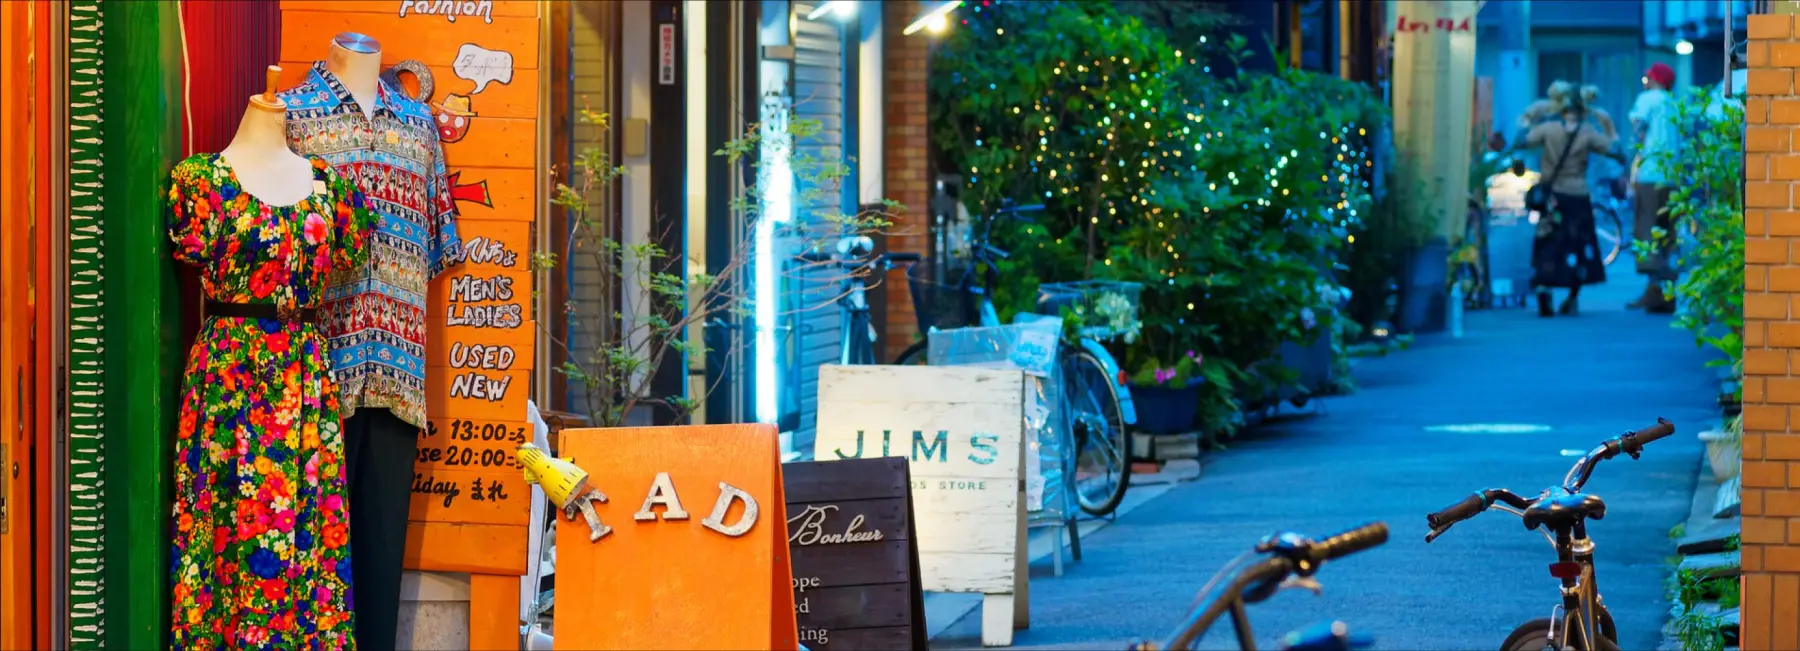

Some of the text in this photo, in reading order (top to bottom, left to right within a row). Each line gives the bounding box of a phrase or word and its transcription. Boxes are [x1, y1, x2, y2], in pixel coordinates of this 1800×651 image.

[449, 274, 514, 303] MEN'S
[449, 340, 516, 371] USED
[450, 371, 512, 403] NEW
[834, 430, 999, 465] JIMS
[471, 477, 508, 502] まれ
[939, 480, 986, 490] STORE
[565, 472, 761, 544] TAD
[787, 504, 884, 546] Bonheur
[798, 625, 829, 645] ing
